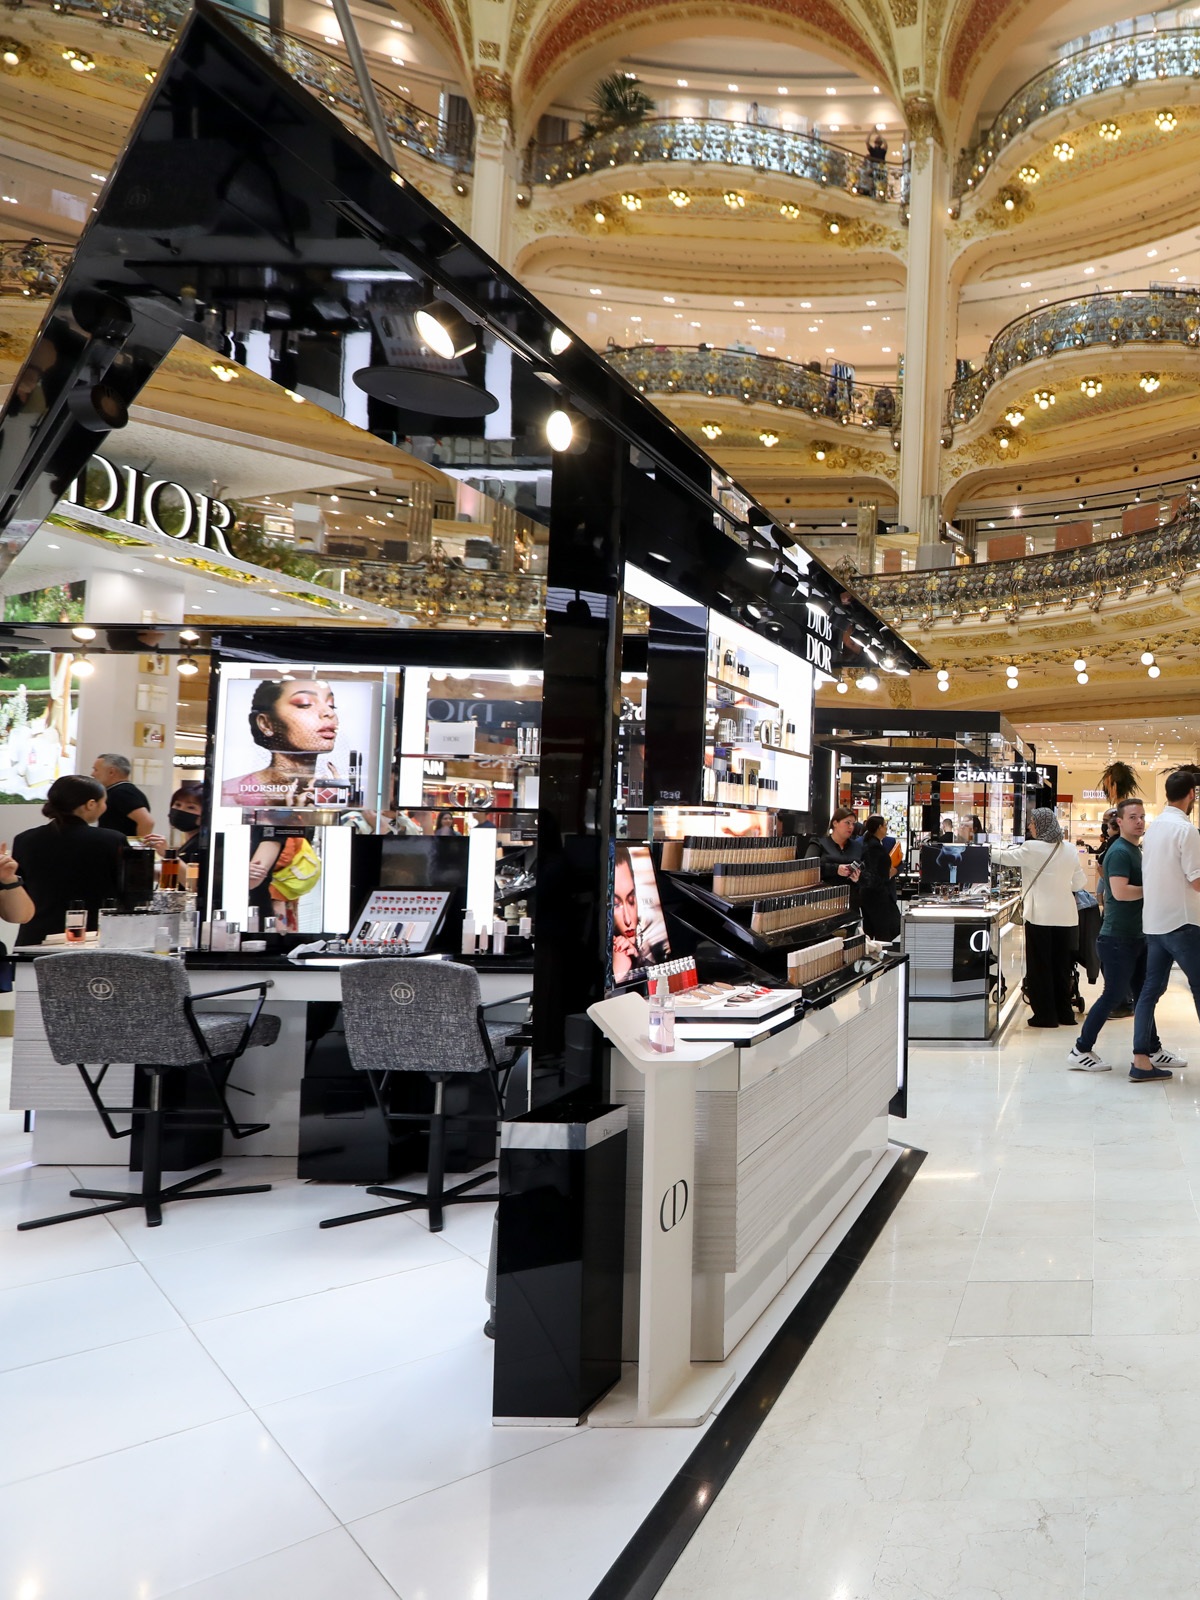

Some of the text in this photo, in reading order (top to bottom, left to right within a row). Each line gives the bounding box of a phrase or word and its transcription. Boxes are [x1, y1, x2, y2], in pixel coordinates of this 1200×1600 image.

[62, 453, 239, 564] DIOR
[806, 633, 832, 673] DIOR
[240, 784, 298, 793] DIORSHOW
[957, 770, 1014, 782] CHANEL
